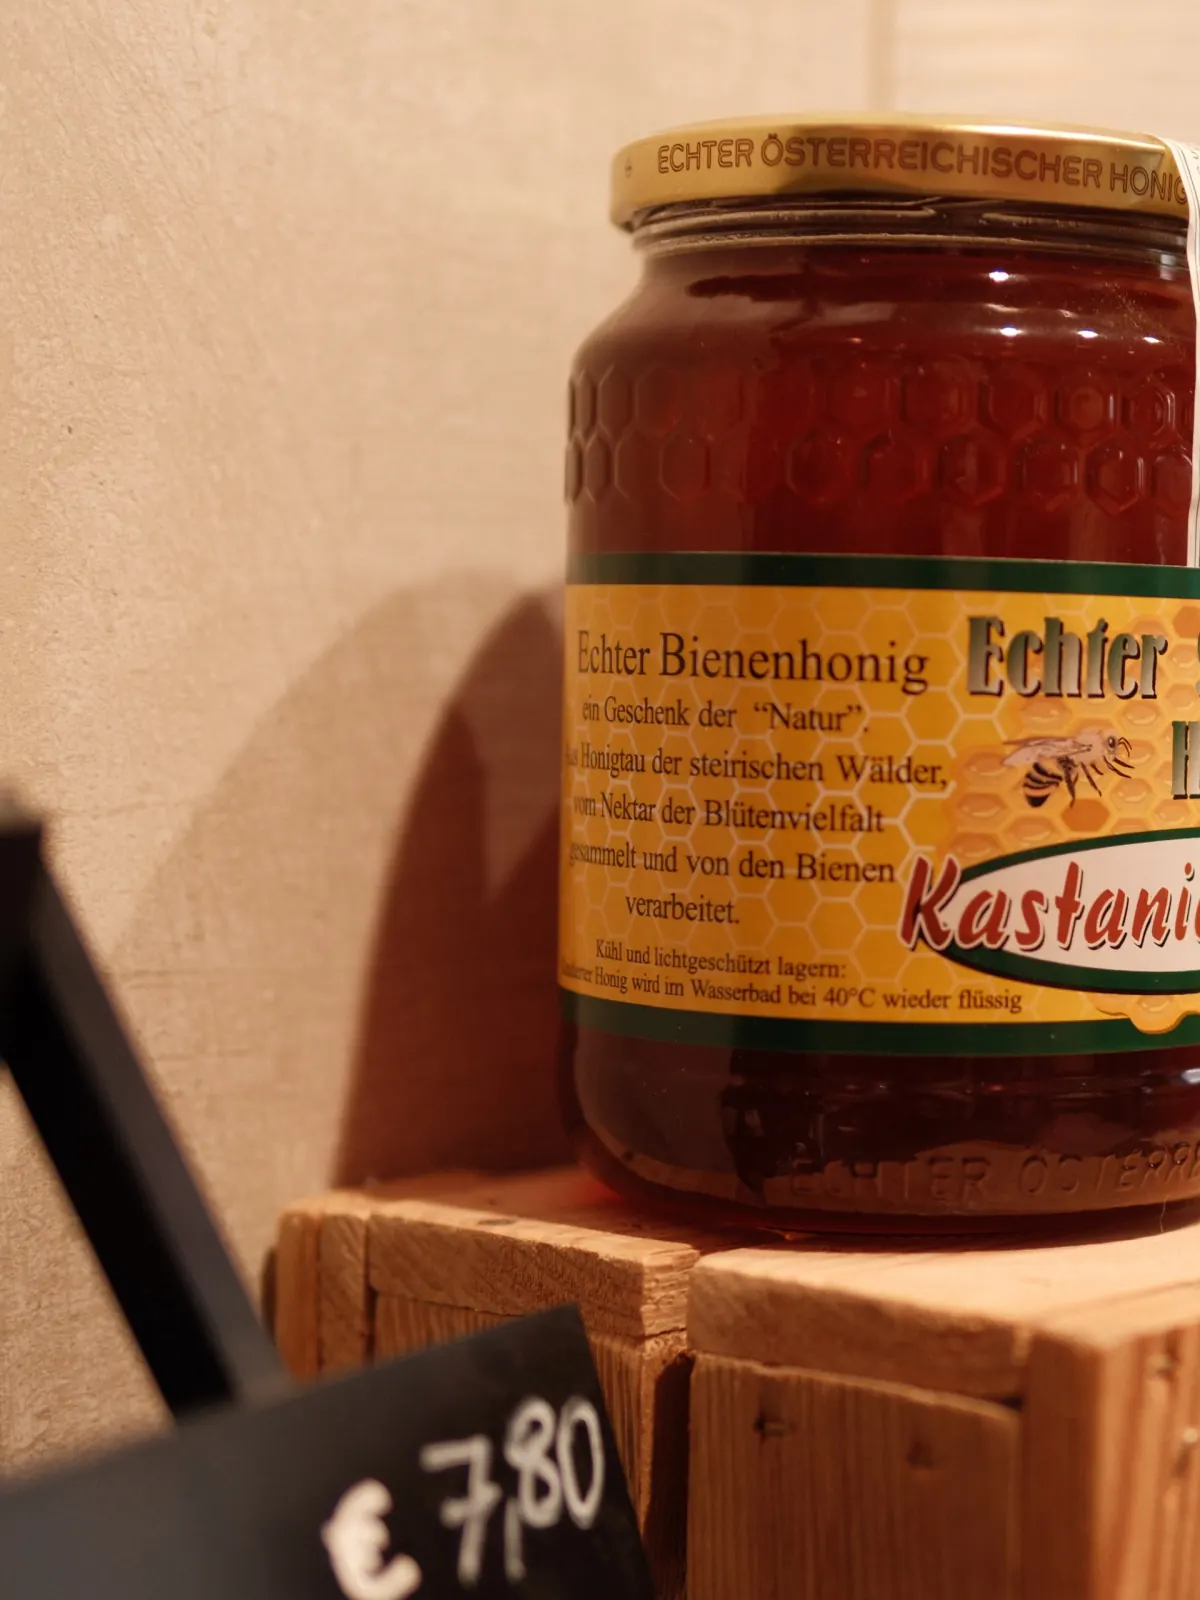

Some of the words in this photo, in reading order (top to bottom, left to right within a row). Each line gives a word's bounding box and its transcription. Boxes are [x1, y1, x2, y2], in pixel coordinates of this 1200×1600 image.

[657, 138, 754, 174] ECHTER
[761, 132, 1103, 188] ÖSTERREICHISCHER
[1109, 162, 1187, 205] HONIG
[577, 630, 650, 676] Echter
[659, 632, 930, 695] Bienenhonig
[966, 615, 1169, 700] Echter
[582, 694, 600, 722] ein
[604, 695, 690, 727] Geschenk
[698, 698, 738, 728] der
[581, 741, 647, 779] Honigtau
[652, 747, 682, 776] der
[690, 750, 824, 782] steirischen
[836, 754, 948, 788] Wälder,
[600, 790, 656, 822] Nektar
[661, 797, 696, 826] der
[704, 798, 886, 834] Blütenvielfalt
[643, 845, 678, 873] und
[686, 854, 731, 877] von
[738, 850, 785, 880] den
[796, 852, 897, 883] Bienen
[625, 893, 741, 925] verarbeitet.
[596, 939, 622, 962] Kühl
[626, 945, 651, 965] und
[654, 948, 772, 976] lichtgeschützt
[594, 965, 628, 995] Honig
[632, 974, 660, 994] wird
[664, 975, 685, 997] im
[690, 978, 782, 1005] Wasserbad
[788, 985, 817, 1006] bei
[823, 987, 876, 1009] 40°C
[882, 988, 952, 1011] wieder
[957, 989, 1023, 1014] flüssig
[418, 1395, 606, 1589] 7,80
